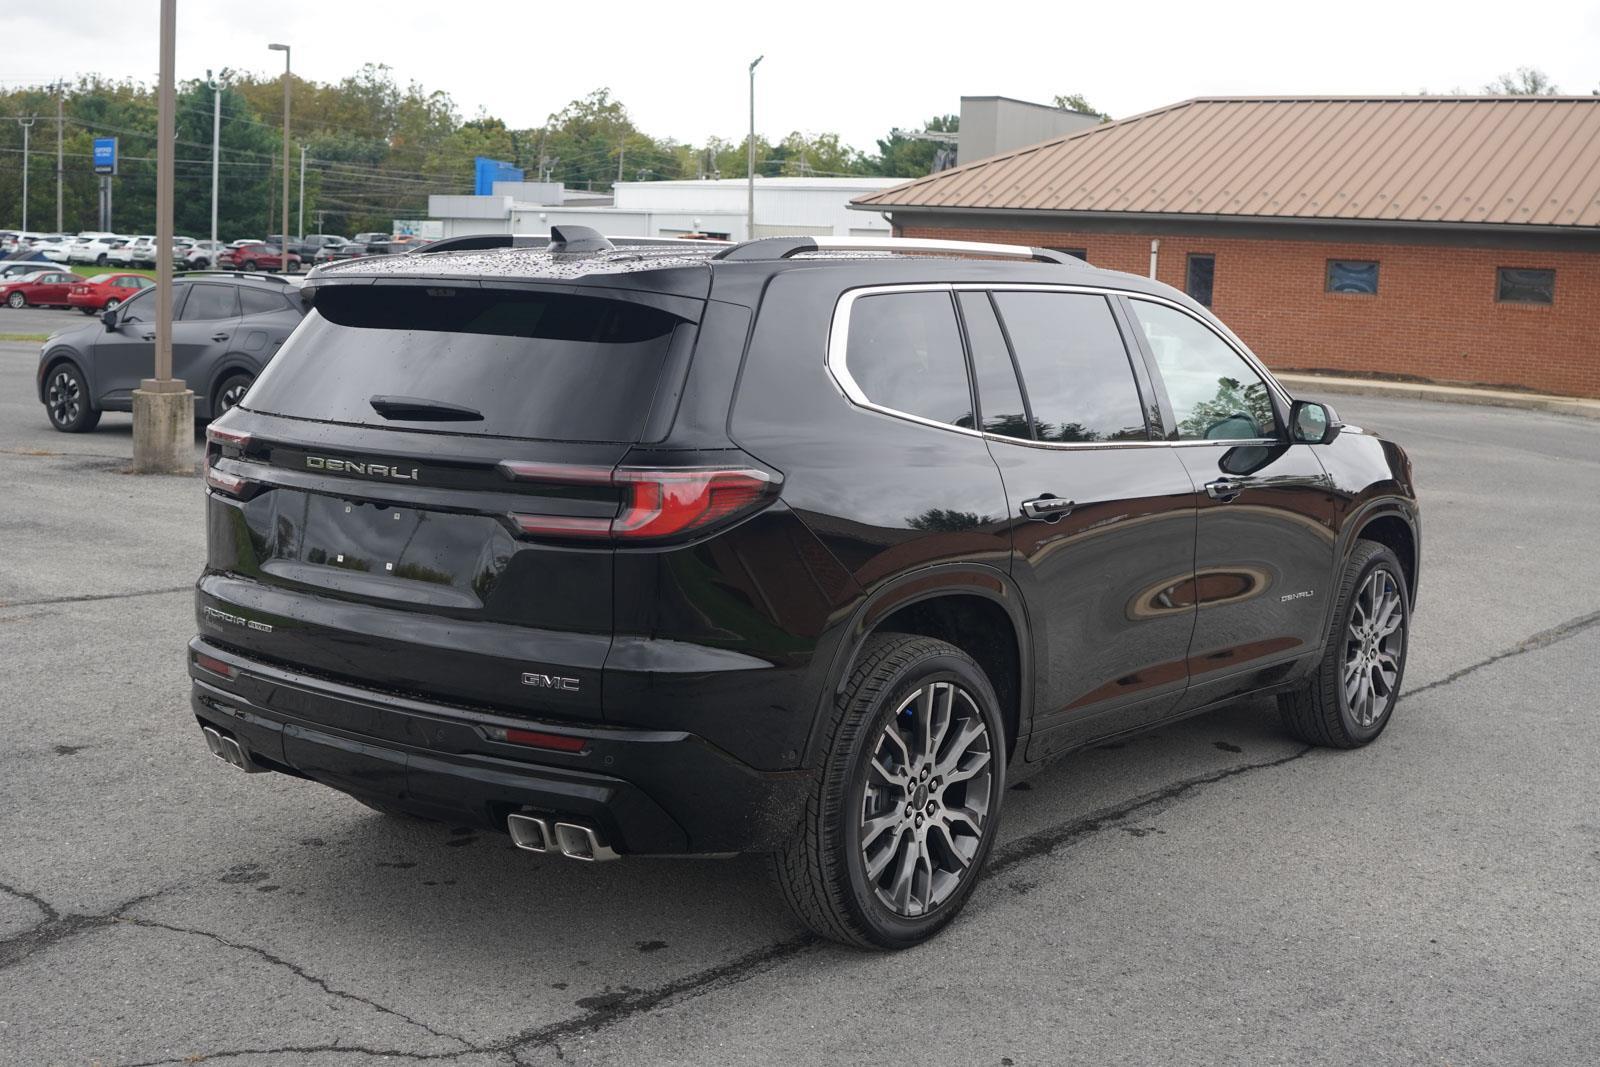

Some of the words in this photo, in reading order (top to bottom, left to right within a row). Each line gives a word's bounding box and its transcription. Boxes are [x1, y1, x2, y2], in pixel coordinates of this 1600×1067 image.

[306, 456, 418, 480] DENALI
[1281, 590, 1314, 602] DENALI
[204, 606, 246, 626] ACADIA
[521, 672, 580, 691] GMC
